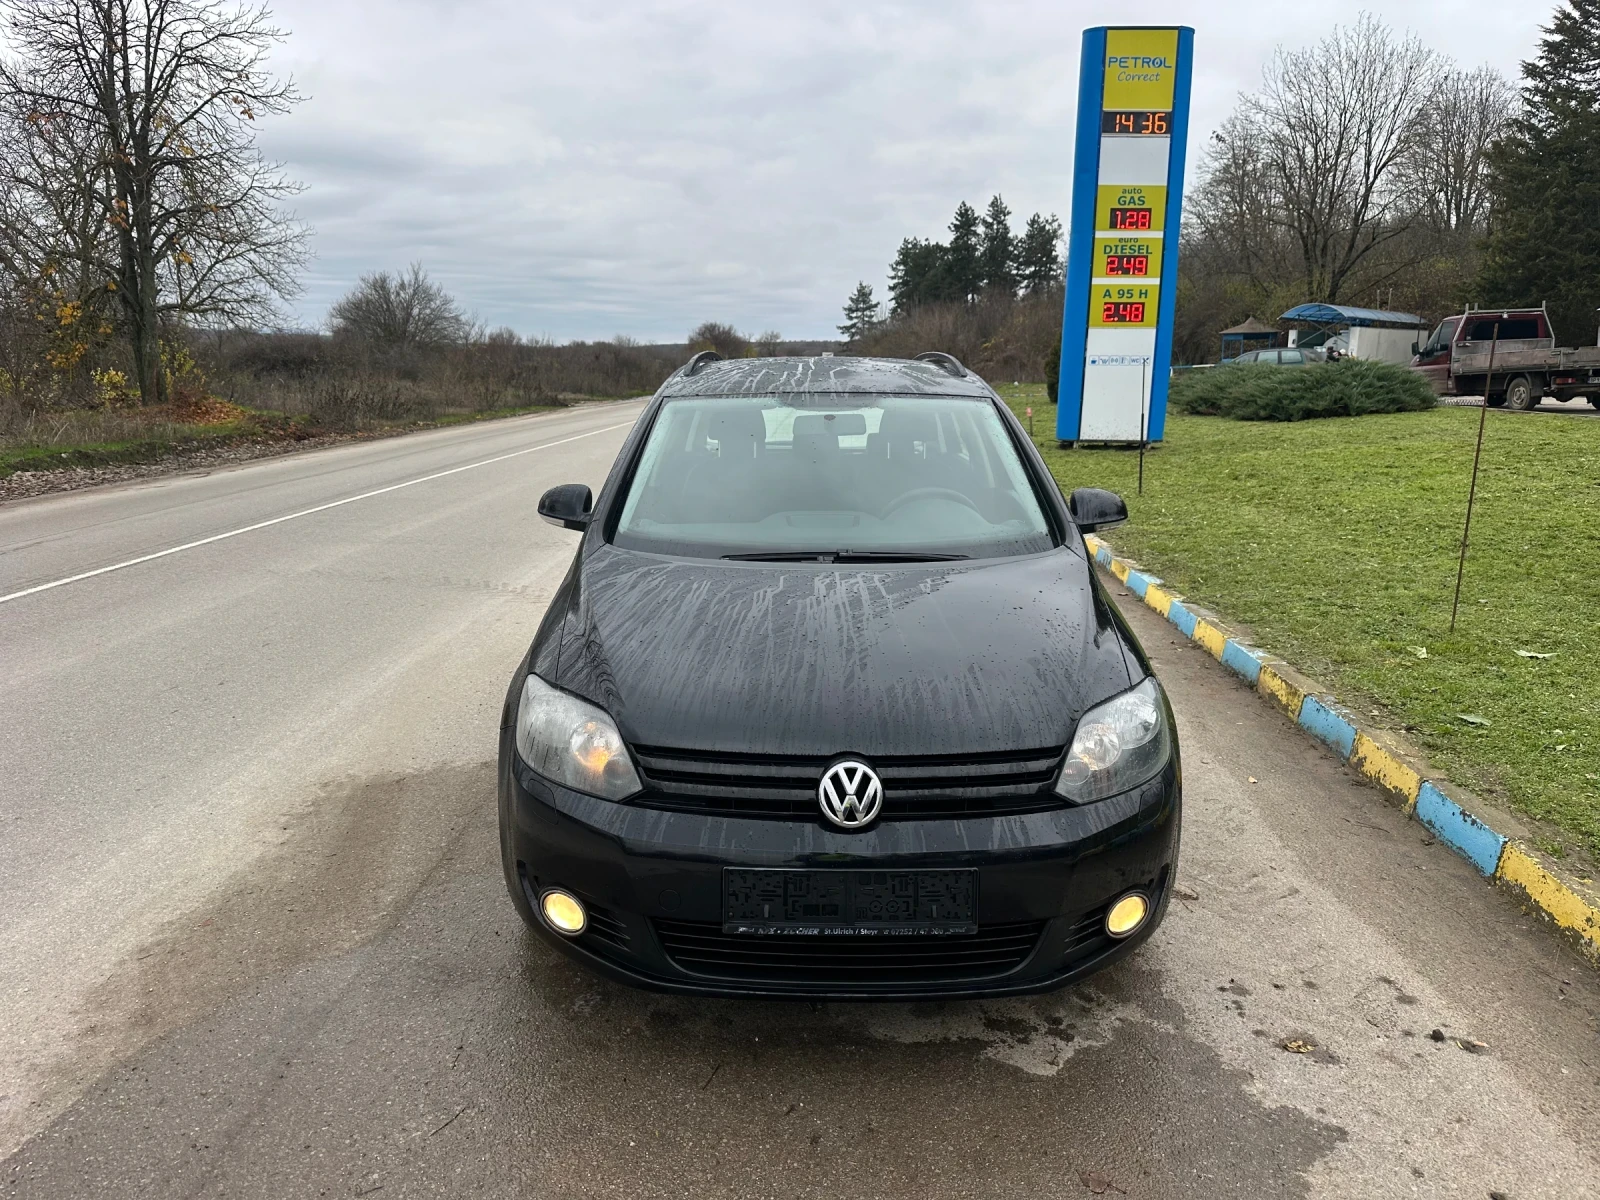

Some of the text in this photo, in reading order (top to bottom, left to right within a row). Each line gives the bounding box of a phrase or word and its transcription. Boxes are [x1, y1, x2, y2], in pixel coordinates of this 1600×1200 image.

[1108, 57, 1172, 69] PETROL
[1117, 71, 1160, 82] Correct
[1122, 187, 1142, 195] auto
[1117, 195, 1146, 206] GAS
[1115, 211, 1150, 229] 1.28
[1103, 244, 1153, 255] DIESEL
[1106, 257, 1147, 275] 2.49
[1103, 289, 1148, 299] A 95 H
[1103, 303, 1143, 322] 2.48
[819, 761, 882, 828] VW
